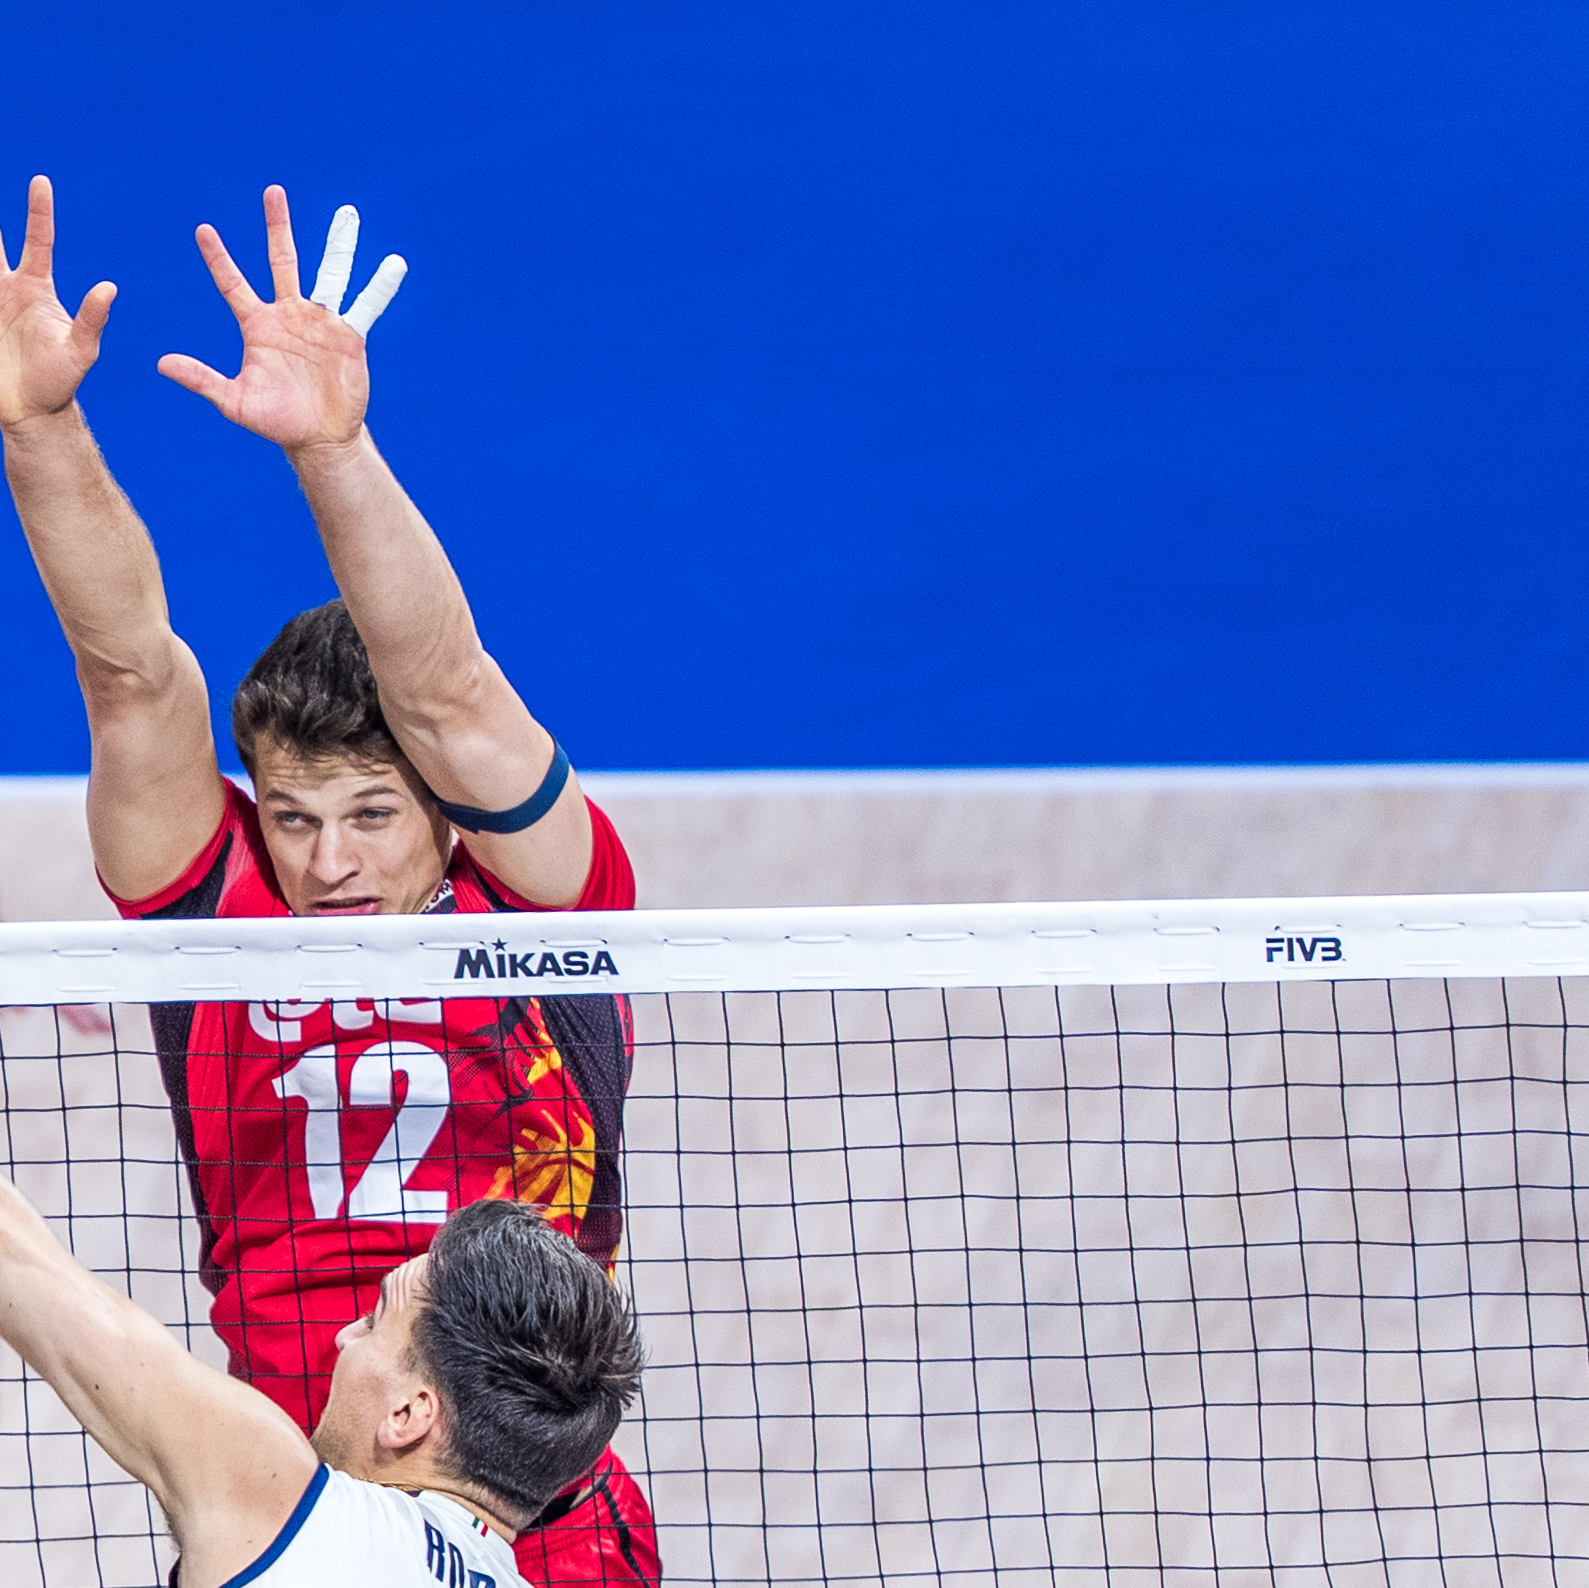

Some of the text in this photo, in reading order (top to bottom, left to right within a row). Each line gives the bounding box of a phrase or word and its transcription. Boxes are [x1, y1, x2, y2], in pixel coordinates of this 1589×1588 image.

[454, 938, 620, 979] MIKASA
[1265, 937, 1343, 963] FIVB
[271, 1039, 453, 1226] 12
